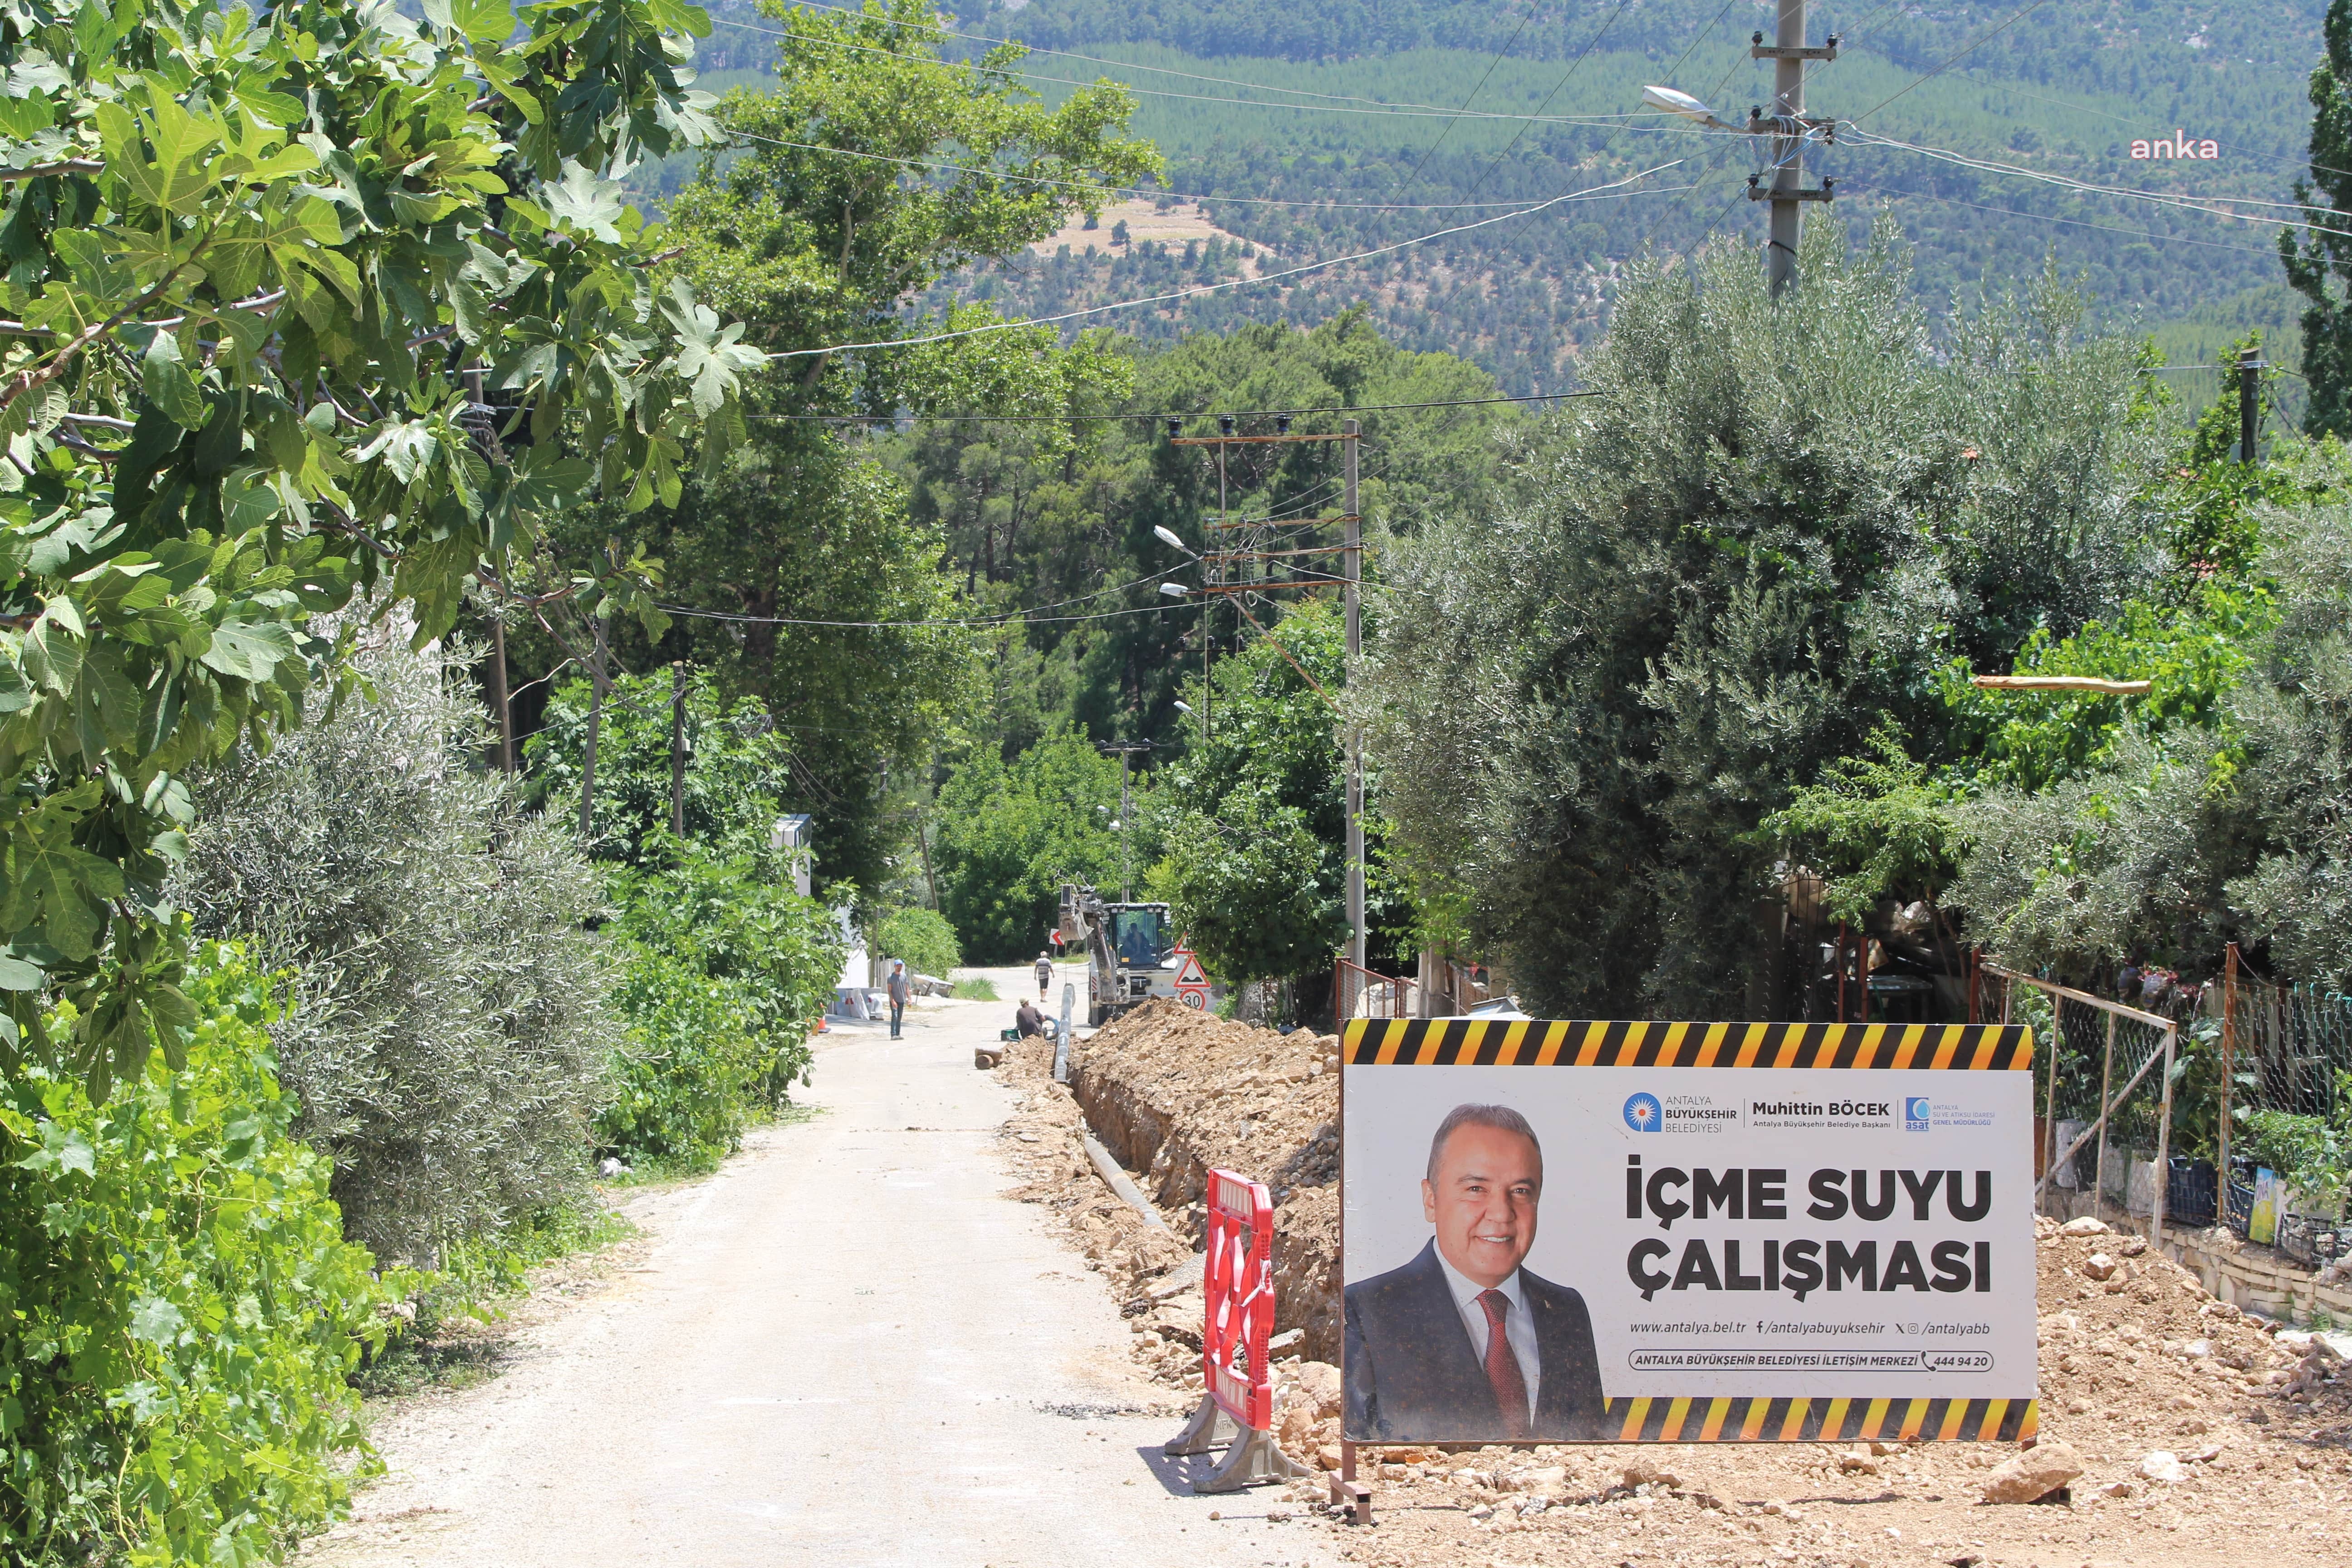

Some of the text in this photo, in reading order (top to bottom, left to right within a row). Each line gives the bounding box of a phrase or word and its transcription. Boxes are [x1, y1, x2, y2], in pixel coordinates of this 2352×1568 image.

[1185, 995, 1200, 1007] 30
[1666, 1096, 1712, 1105] ANTALYA
[1666, 1107, 1737, 1121] BÜYÜKŞEHİR
[1753, 1100, 1890, 1116] Muhittin BÖCEK
[1666, 1122, 1722, 1132] BELEDİYESİ
[1627, 1154, 1991, 1230] İÇME SUYU
[1627, 1238, 1991, 1303] ÇALIŞMASI
[1630, 1321, 1746, 1334] www.antalya.bel.tr
[1765, 1321, 1885, 1335] /antalyabuyuksehir
[1921, 1322, 1990, 1336] /antalyabb
[1635, 1353, 1988, 1367] ANTALYA BÜYÜKŞEHİR BELEDİYESİ İLETİŞİM MERKEZİ 444 94 20
